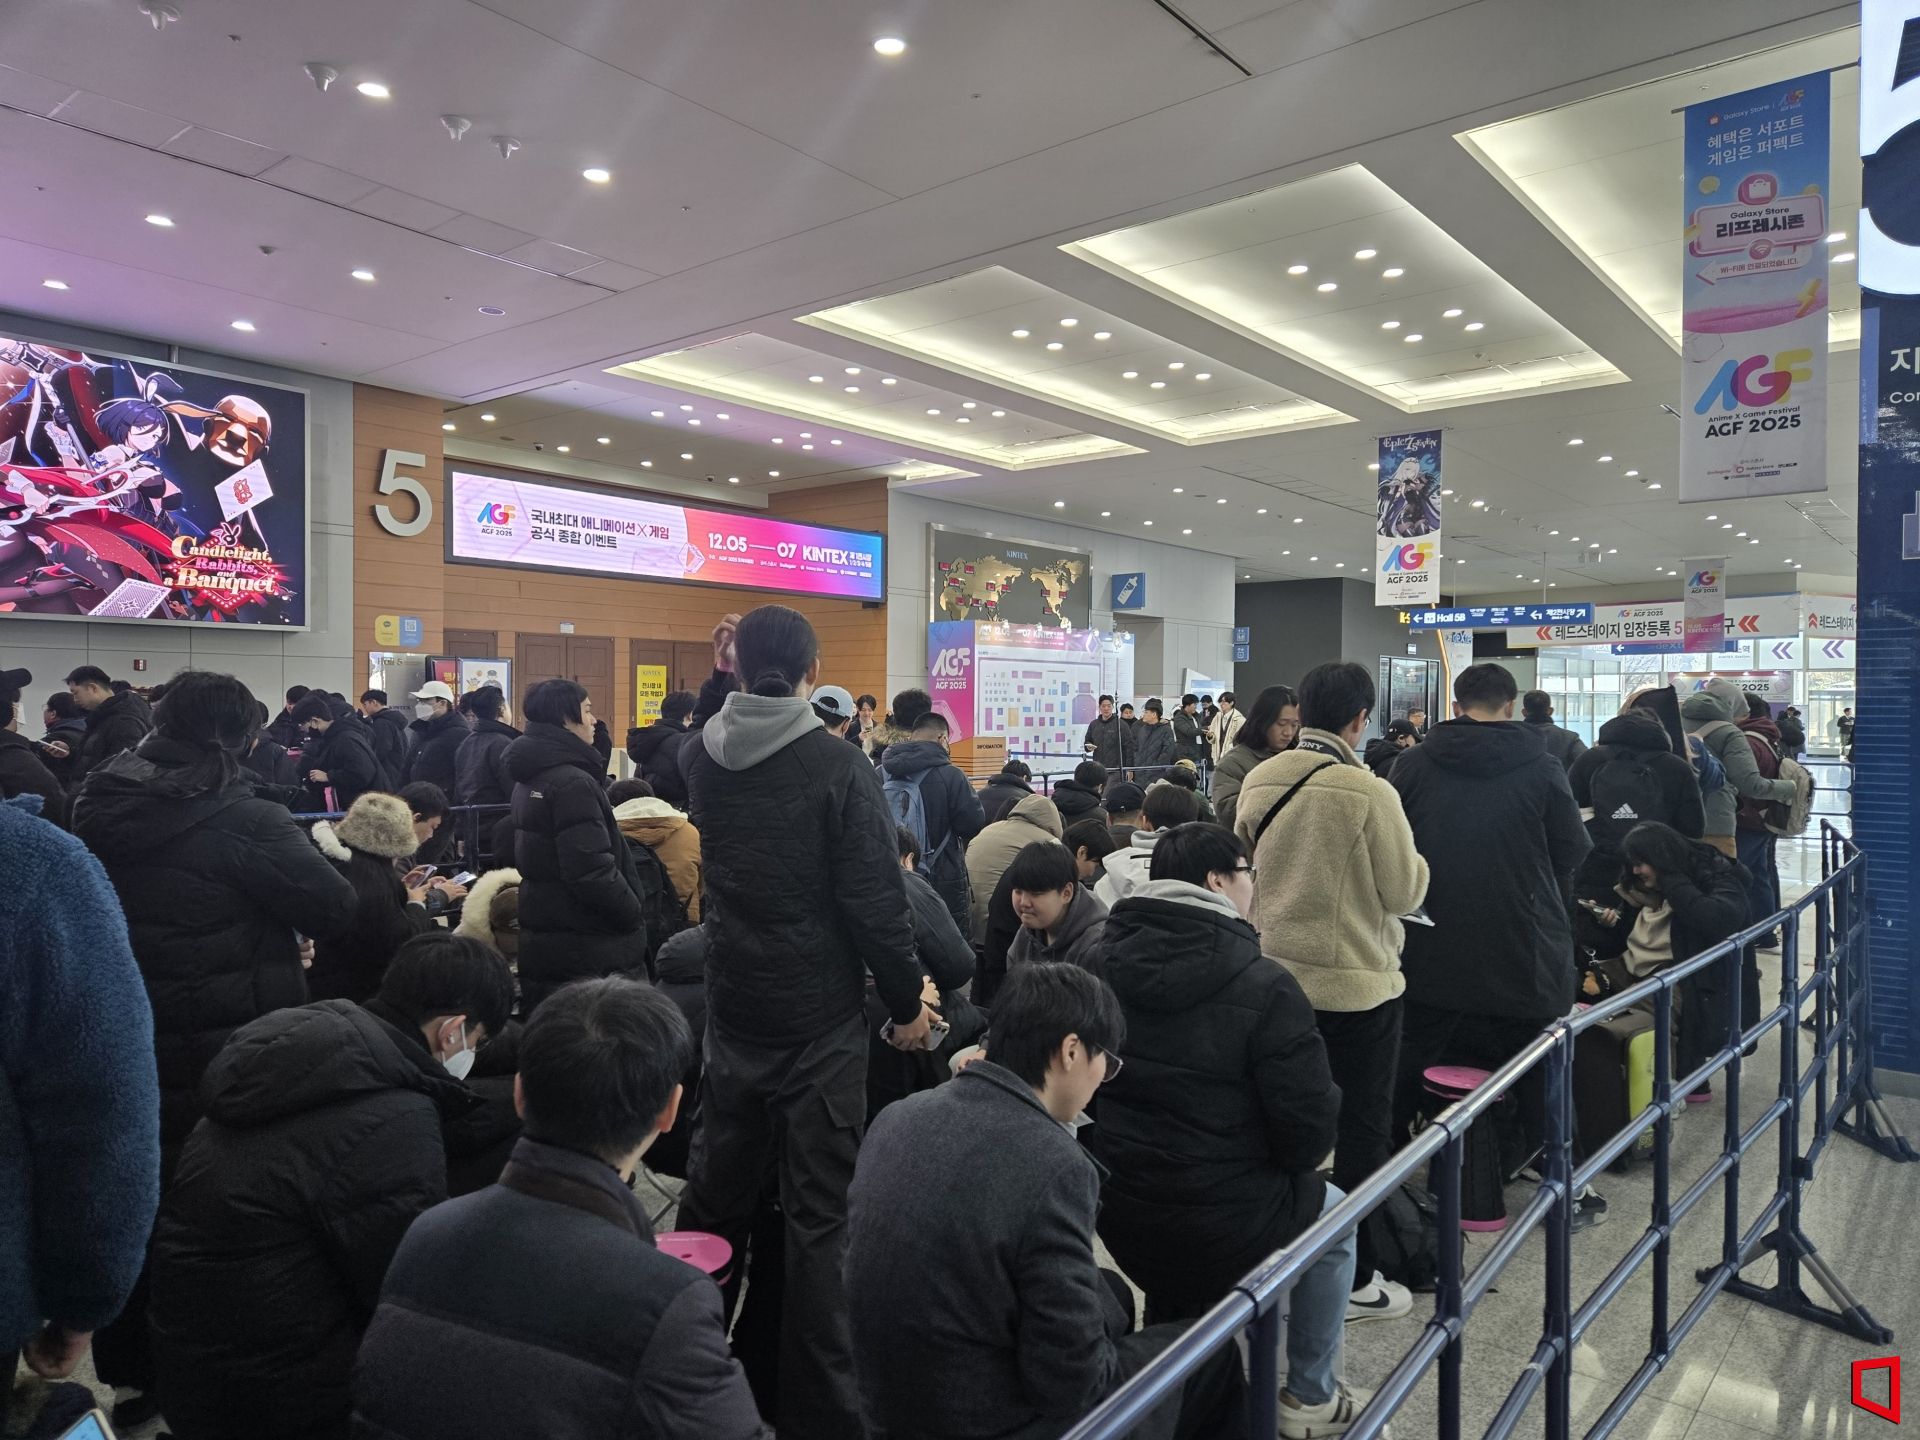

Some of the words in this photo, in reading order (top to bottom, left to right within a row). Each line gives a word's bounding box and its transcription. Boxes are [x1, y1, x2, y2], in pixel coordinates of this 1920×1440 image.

[1723, 110, 1748, 121] Galaxy
[1750, 105, 1770, 114] Store
[1707, 127, 1753, 149] 혜택은
[1757, 114, 1805, 136] 서포트
[1707, 145, 1753, 166] 게임은
[1756, 132, 1805, 154] 퍼펙트
[1730, 209, 1763, 219] Galaxy
[1765, 207, 1789, 215] Store
[1716, 214, 1805, 238] 리프레시존
[1694, 348, 1813, 415] AGF
[1708, 415, 1733, 423] Anime
[1768, 405, 1800, 415] Festival
[1705, 420, 1744, 439] AGF
[1749, 414, 1802, 433] 2025
[370, 449, 433, 537] 5
[477, 502, 516, 526] AGF
[531, 509, 579, 528] 국내최대
[581, 516, 636, 535] 애니메이션
[649, 525, 670, 539] 게임
[495, 529, 513, 537] 2025
[531, 525, 555, 542] 공식
[558, 529, 581, 545] 종합
[584, 533, 617, 549] 이벤트
[171, 535, 272, 562] Candlelight,
[708, 532, 748, 553] 12.05
[802, 545, 849, 566] KINTEX
[1006, 550, 1028, 560] KINTEX
[1383, 543, 1434, 571] AGF
[195, 557, 258, 575] Rabbits,
[175, 568, 275, 595] Banquet
[1387, 576, 1404, 584] AGF
[1406, 575, 1428, 583] 2025
[1437, 613, 1453, 622] Hall
[1555, 622, 1620, 640] 레드스테이지
[1624, 620, 1671, 638] 입장등록
[1724, 618, 1735, 634] 구
[931, 647, 971, 677] AGF
[935, 682, 948, 690] AGF
[949, 681, 967, 690] 2025
[1300, 741, 1323, 750] ONY
